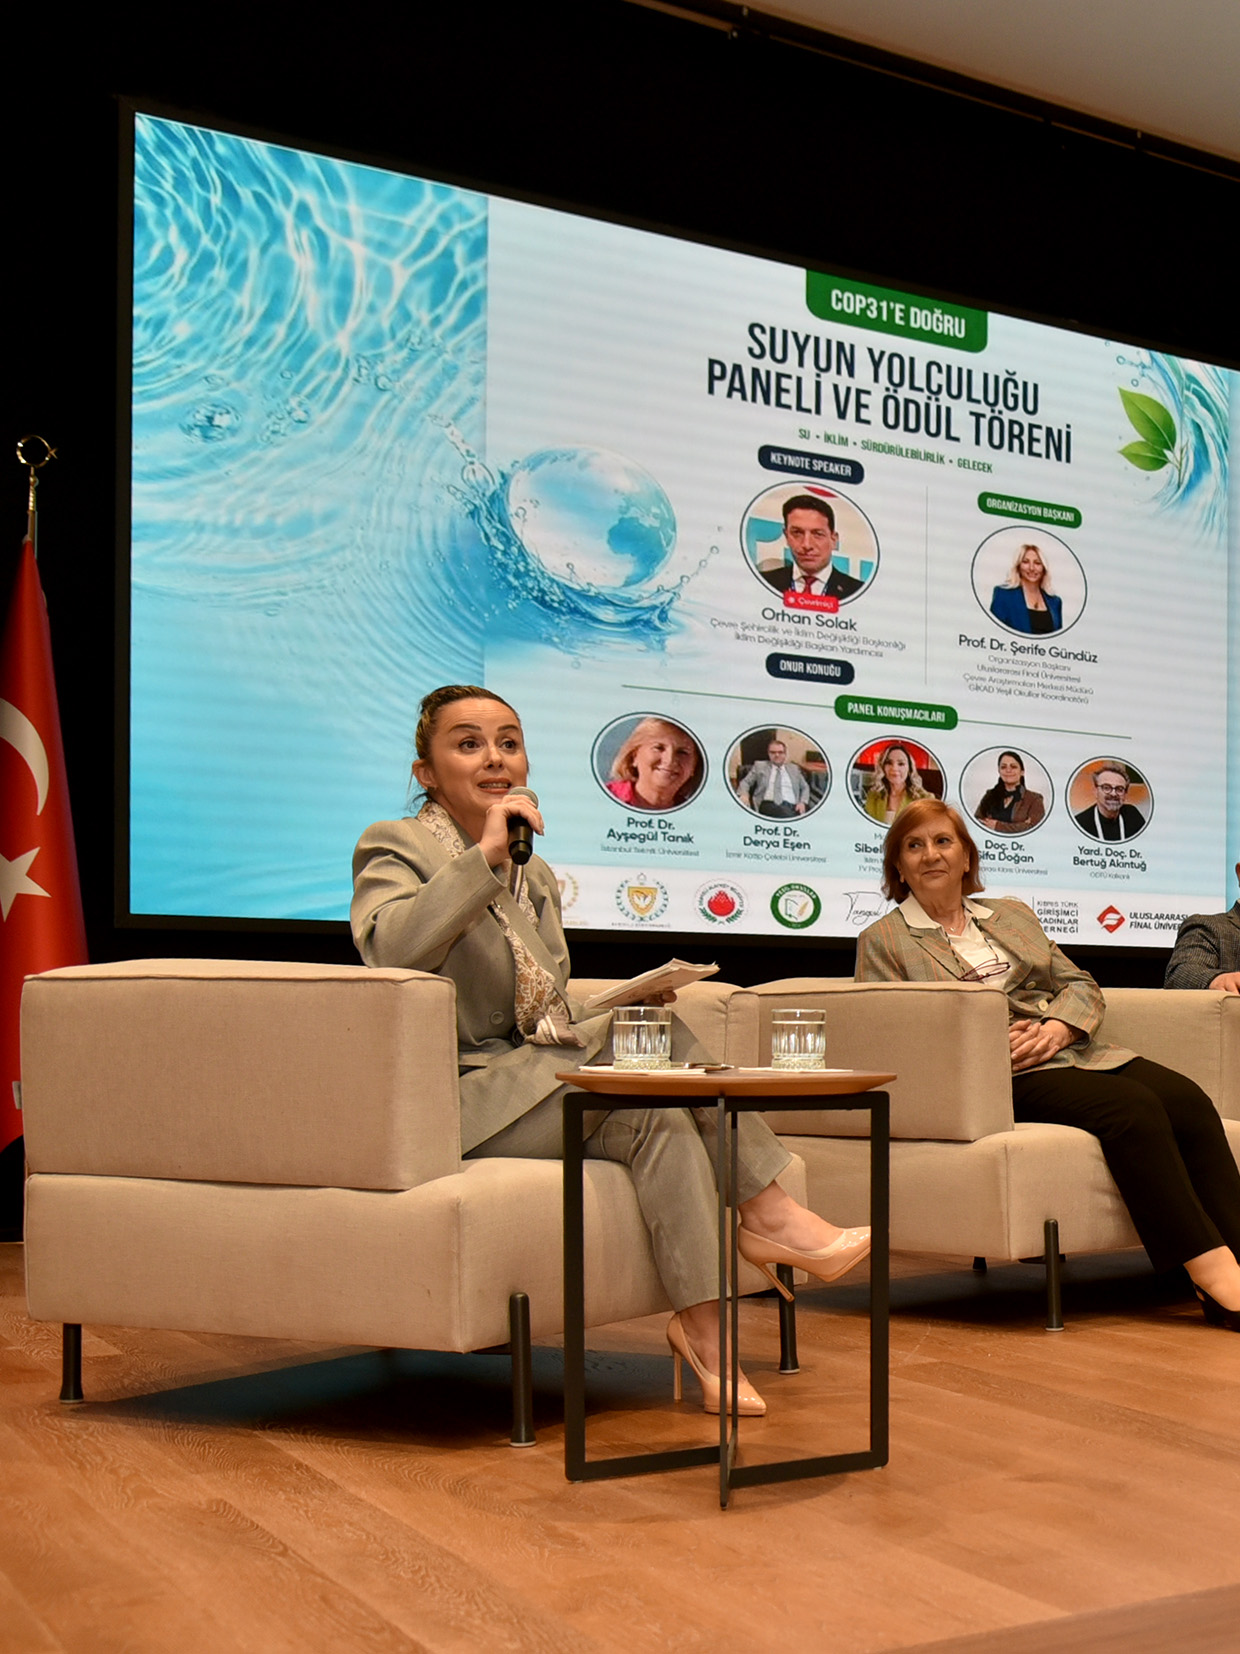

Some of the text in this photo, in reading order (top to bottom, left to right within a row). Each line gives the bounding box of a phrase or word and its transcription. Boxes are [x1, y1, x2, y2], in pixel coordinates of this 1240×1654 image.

[831, 289, 966, 339] COP31'E DOĞRU
[747, 322, 1039, 416] SUYUN YOLCULUĞU
[707, 358, 1072, 464] PANELİ VE ÖDÜL TÖRENİ
[799, 427, 811, 440] SU
[824, 431, 849, 447] İKLİM
[957, 457, 993, 473] GELECEK
[770, 451, 852, 477] KEYNOTE SPEAKER
[986, 497, 1075, 522] ORGANİZASYON BAŞKANI
[761, 607, 857, 632] Orhan Solak
[959, 634, 1098, 663] Prof. Dr. Şerife Gündüz
[779, 659, 841, 677] ONUR KONUĞU
[847, 702, 945, 722] PANEL KONUŞMACILARI
[627, 817, 675, 831] Prof. Dr.
[754, 824, 799, 837] Prof. Dr.
[607, 828, 694, 844] Ayşegül Tanık
[743, 836, 811, 851] Derya Eşen
[854, 842, 883, 854] Sibel
[985, 839, 1025, 853] Doç. Dr.
[1078, 845, 1143, 860] Yard. Doç. Dr.
[999, 852, 1034, 864] Doğan
[1073, 856, 1147, 872] Bertuğ Akıntuğ
[1037, 908, 1079, 918] GİRİŞİMCİ
[1129, 920, 1152, 930] FİNAL
